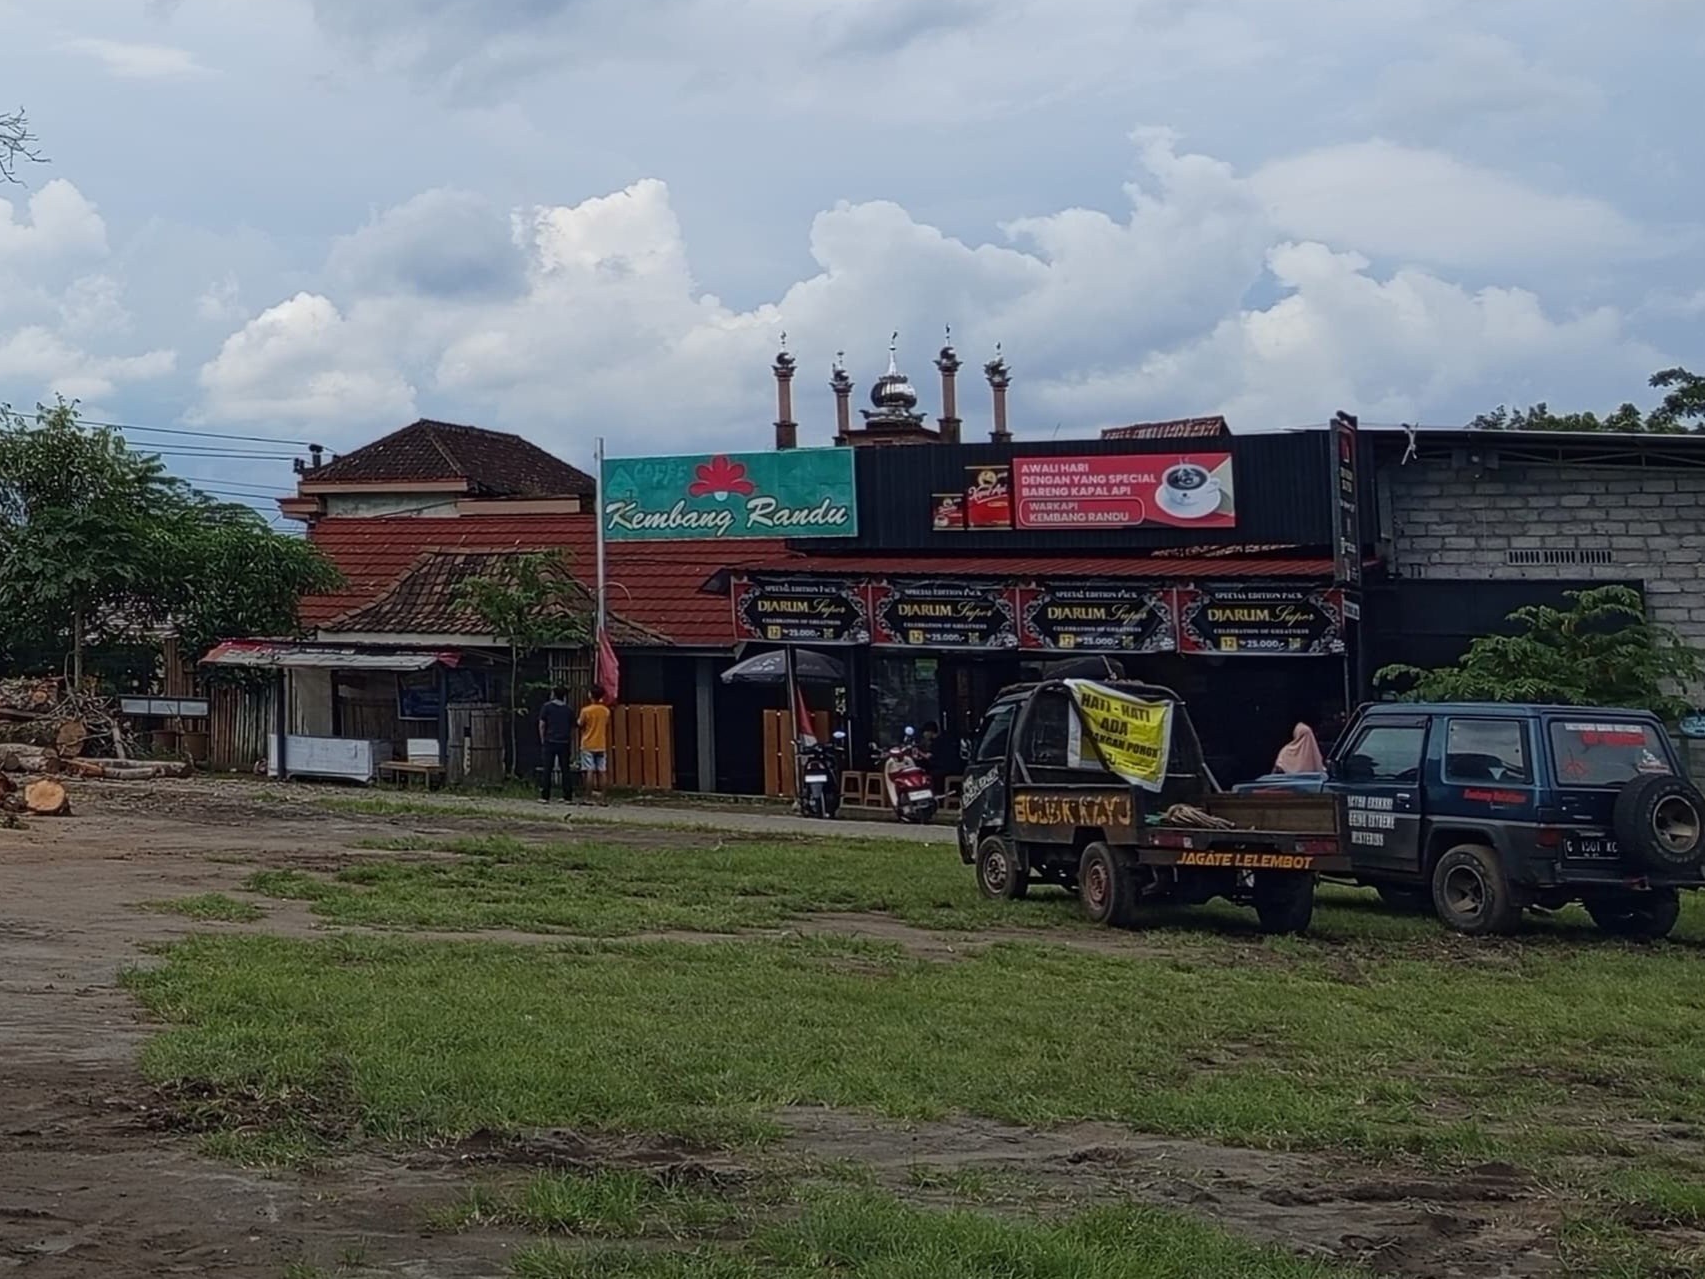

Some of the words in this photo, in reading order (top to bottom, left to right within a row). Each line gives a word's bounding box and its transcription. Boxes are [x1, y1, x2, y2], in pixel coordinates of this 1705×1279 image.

[1021, 464, 1060, 473] AWALI
[1061, 463, 1089, 473] HARI
[1021, 476, 1070, 485] DENGAN
[1072, 475, 1107, 485] YANG
[1109, 474, 1156, 484] SPECIAL
[1022, 487, 1069, 497] BARENG
[1071, 486, 1110, 496] KAPAL
[1110, 486, 1131, 495] API
[1029, 502, 1078, 511] WARKAPI
[605, 498, 735, 537] Kembang
[746, 497, 848, 529] Randu
[1029, 512, 1087, 522] KEMBANG
[1088, 511, 1129, 522] RANDU
[757, 600, 808, 613] DJARUM
[809, 598, 846, 618] Super
[897, 603, 952, 616] DJARUM
[953, 601, 993, 622] Super
[1047, 607, 1106, 620] DJARUM
[1106, 604, 1148, 625] Super
[1207, 609, 1270, 622] DJARUM
[1271, 605, 1315, 626] Super
[1081, 693, 1111, 713] HATI
[1121, 704, 1151, 723] HATI
[1100, 717, 1128, 736] ADA
[1234, 854, 1313, 869] LELEMBOT
